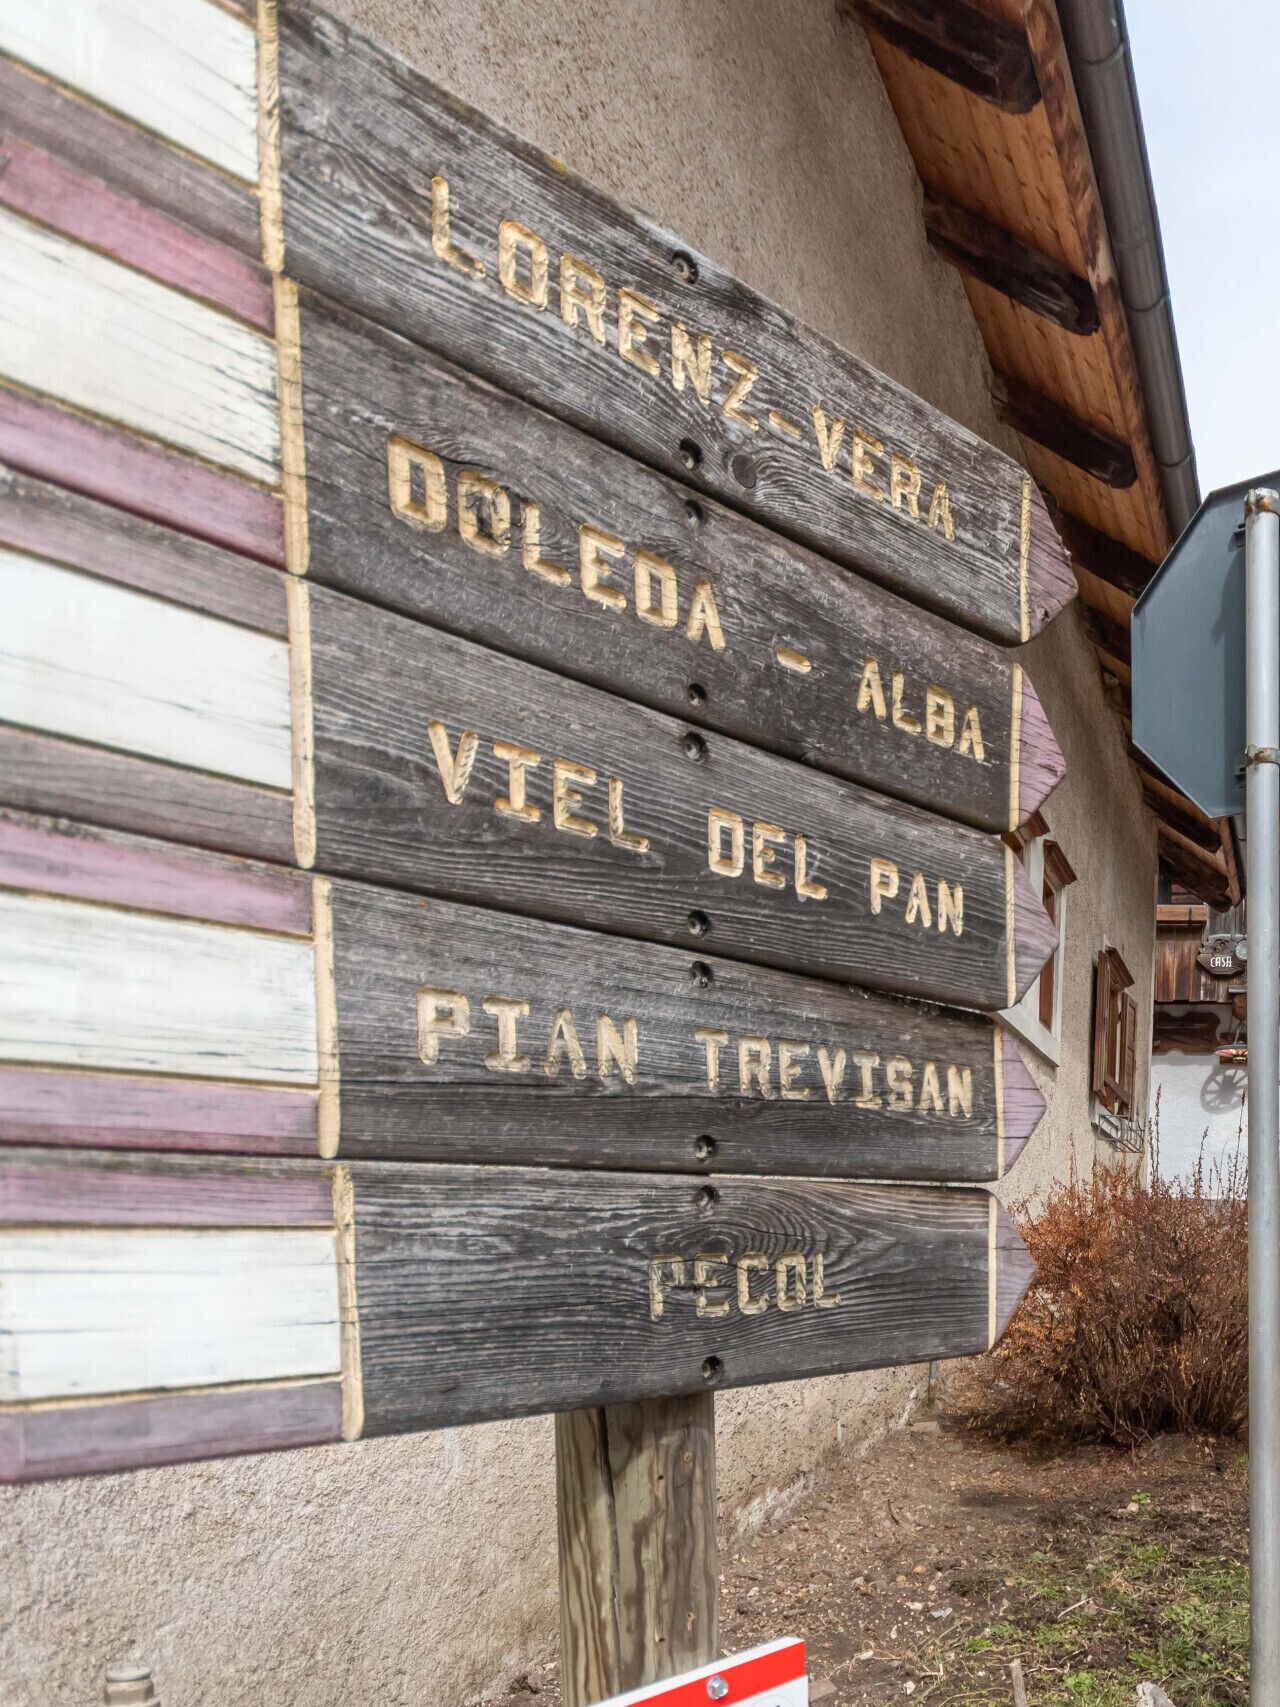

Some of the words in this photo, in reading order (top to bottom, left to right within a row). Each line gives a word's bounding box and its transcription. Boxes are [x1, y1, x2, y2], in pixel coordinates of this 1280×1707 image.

[857, 659, 985, 763] ALBA
[427, 720, 651, 853] VIEL
[708, 807, 828, 901] DEL
[870, 857, 964, 936] PAN
[416, 984, 639, 1086] PIAN
[694, 1028, 974, 1119] TREVISAN
[649, 1252, 842, 1322] PECOL
